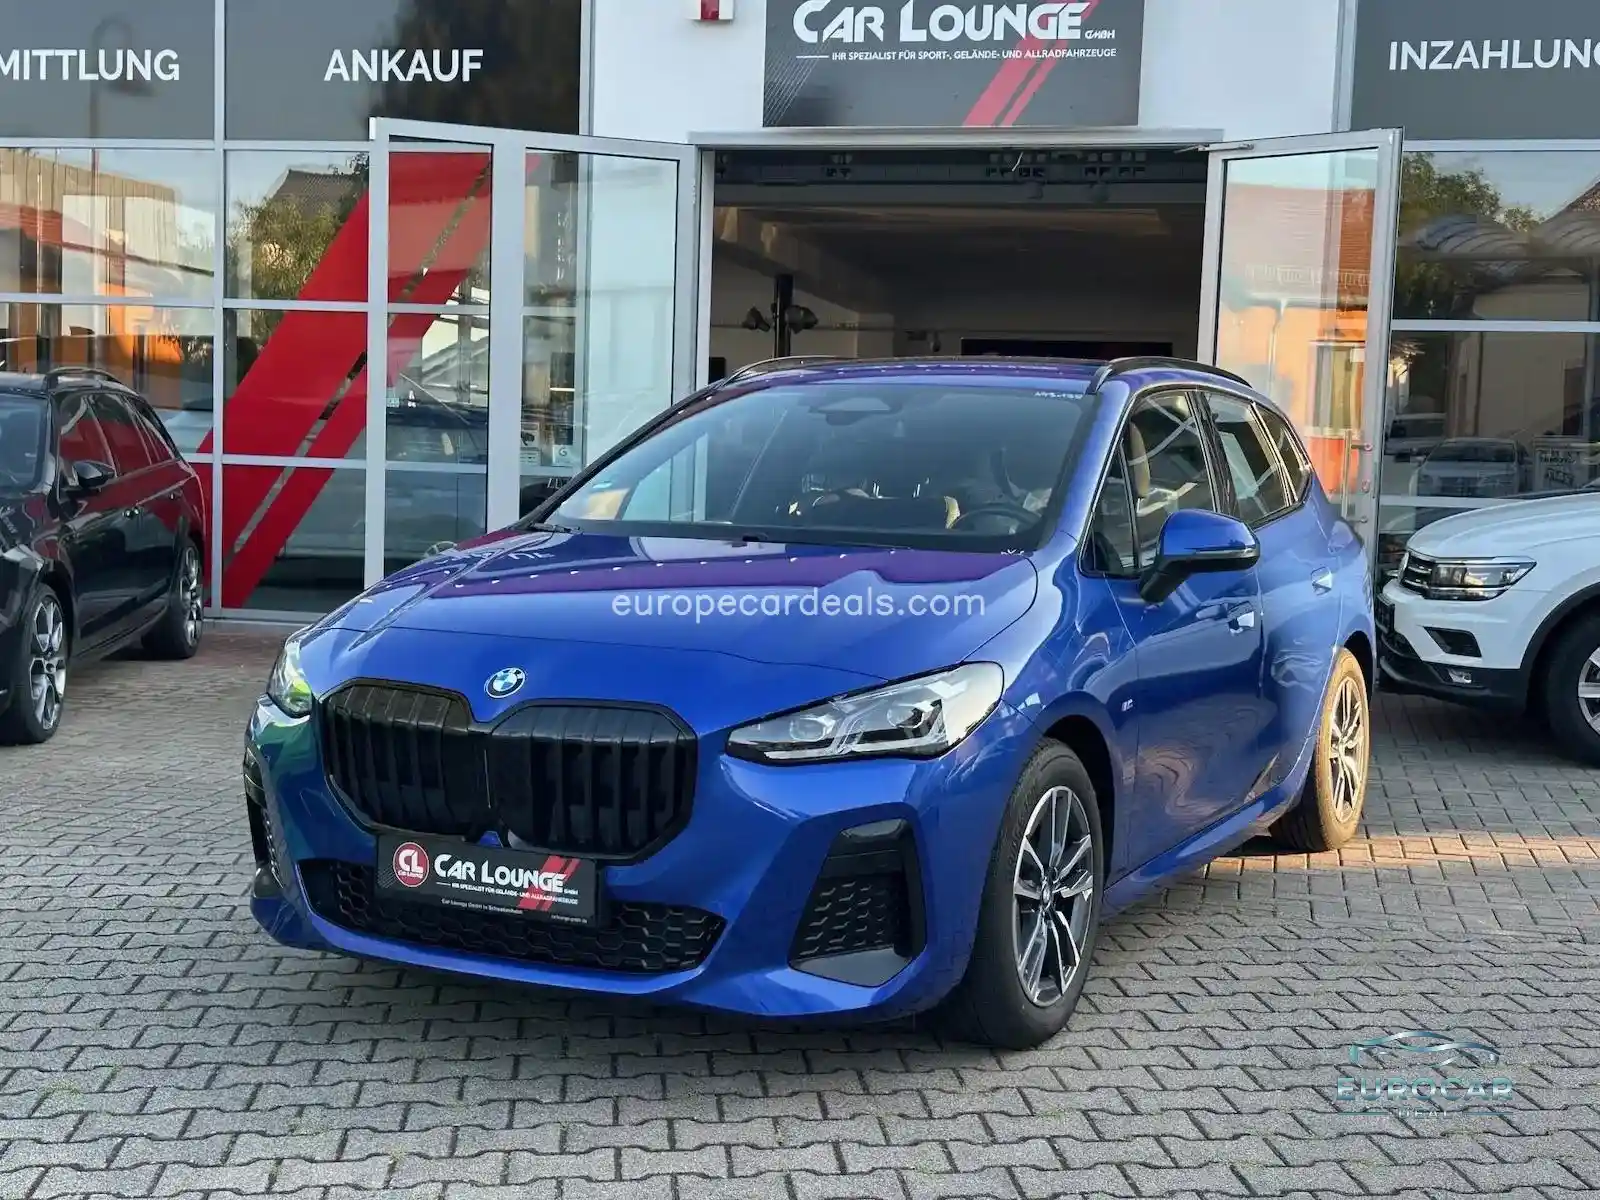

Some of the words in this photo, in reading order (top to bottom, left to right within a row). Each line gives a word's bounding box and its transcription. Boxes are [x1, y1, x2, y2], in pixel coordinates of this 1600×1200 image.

[899, 0, 1091, 42] LOUNGE
[323, 48, 484, 83] ANKAUF
[831, 51, 847, 60] IHR
[848, 50, 897, 60] SPEZIALIST
[898, 49, 916, 60] FÜR
[953, 48, 1001, 60] GELÄNDE-
[1002, 49, 1023, 59] UND
[1023, 48, 1117, 59] ALLRADFAHRZEUGE
[1388, 38, 1600, 71] INZAHLUN
[433, 853, 476, 881] CAR
[480, 860, 568, 893] LOUNGE
